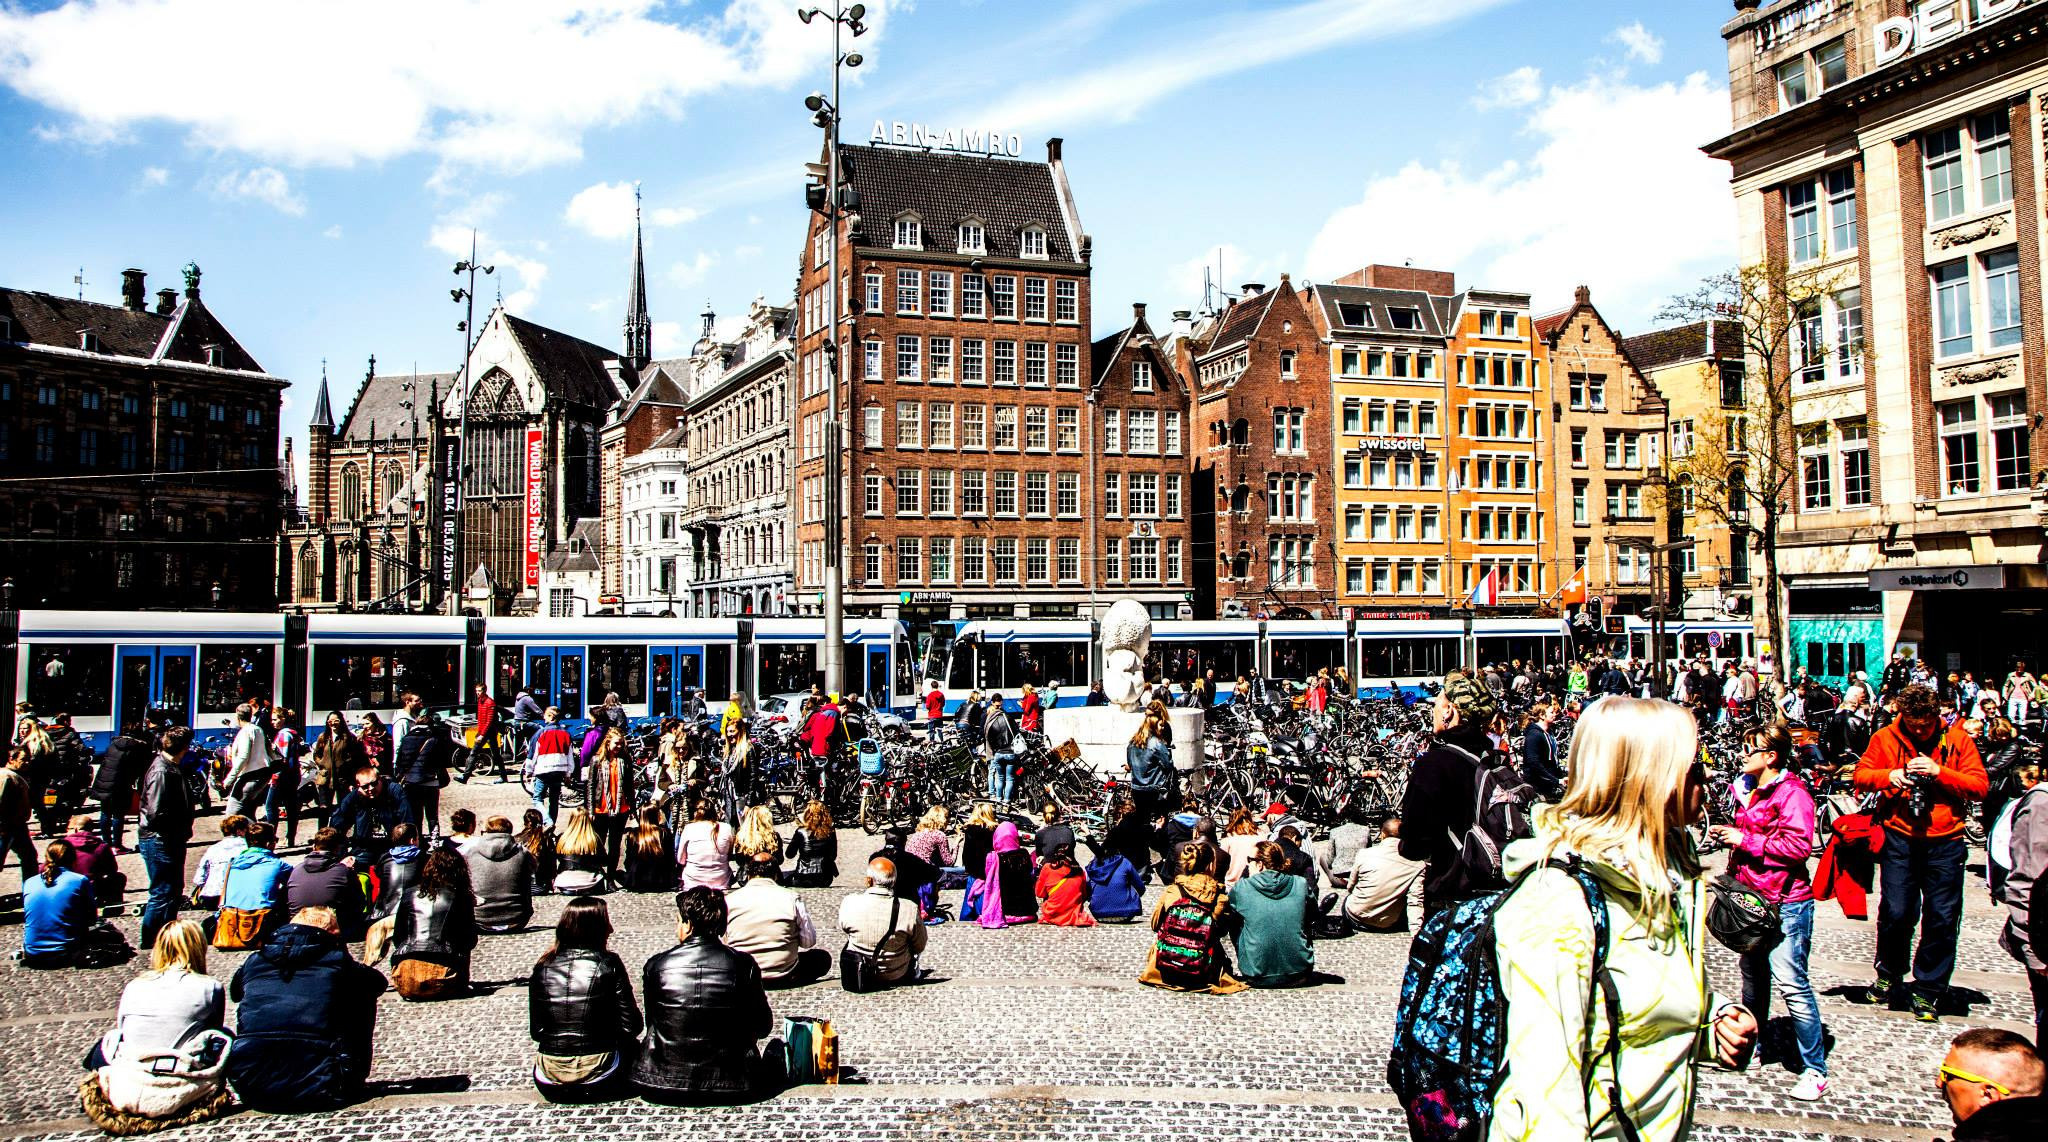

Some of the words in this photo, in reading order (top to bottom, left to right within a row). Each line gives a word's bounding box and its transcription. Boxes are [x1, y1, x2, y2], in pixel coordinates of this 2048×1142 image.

[530, 440, 542, 479] WORLD
[444, 481, 455, 511] 18.04
[530, 482, 541, 514] PRESS
[444, 520, 455, 580] 05.07.2015
[529, 516, 540, 552] PHOTO
